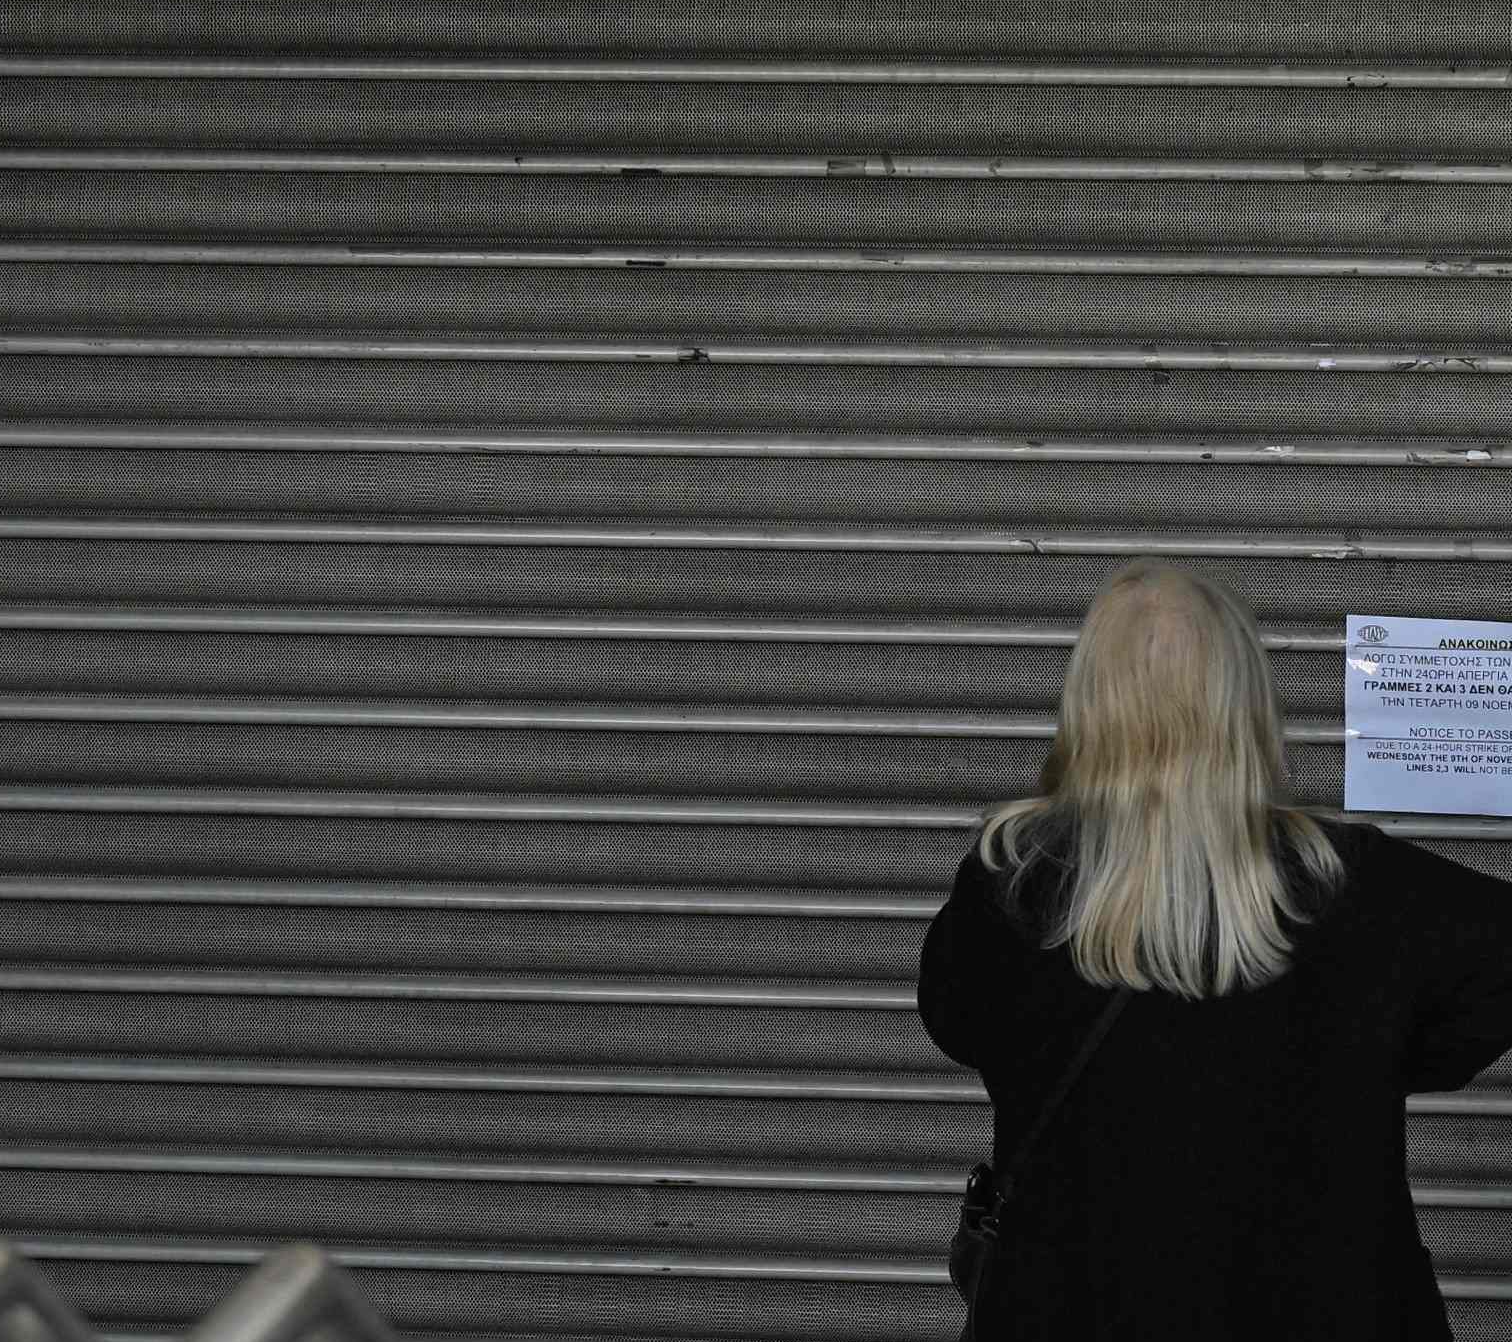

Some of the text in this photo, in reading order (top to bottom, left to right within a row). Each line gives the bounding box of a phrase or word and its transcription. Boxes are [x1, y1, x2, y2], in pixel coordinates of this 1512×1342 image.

[1364, 653, 1396, 664] ΛΟΓΩ
[1399, 654, 1483, 667] ΣΥΜΜΕΤΟΧΗΣ
[1487, 657, 1511, 667] ΤΩΝ
[1381, 667, 1412, 678] ΣΤΗΝ
[1416, 669, 1454, 680] 24ΩΡΗ
[1457, 670, 1509, 681] ΑΠΕΡΓΙΑ
[1364, 680, 1423, 692] ΓΡΑΜΜΕΣ
[1426, 683, 1433, 693] 2
[1436, 683, 1456, 694] ΚΑΙ
[1459, 684, 1466, 694] 3
[1469, 685, 1494, 695] ΔΕΝ
[1381, 696, 1405, 707] ΤΗΝ
[1408, 697, 1462, 709] ΤΕΤΑΡΤΗ
[1466, 699, 1479, 709] 09
[1409, 727, 1454, 738] NOTICE
[1458, 729, 1475, 739] TO
[1375, 741, 1396, 750] DUE
[1398, 742, 1411, 751] TO
[1412, 742, 1420, 751] A
[1465, 744, 1499, 753] STRIKE
[1367, 751, 1427, 761] WEDNESDAY
[1431, 754, 1448, 762] THE
[1450, 754, 1468, 763] 9TH
[1470, 755, 1484, 764] OF
[1406, 764, 1434, 773] LINES
[1453, 765, 1478, 774] WILL
[1479, 766, 1499, 775] NOT
